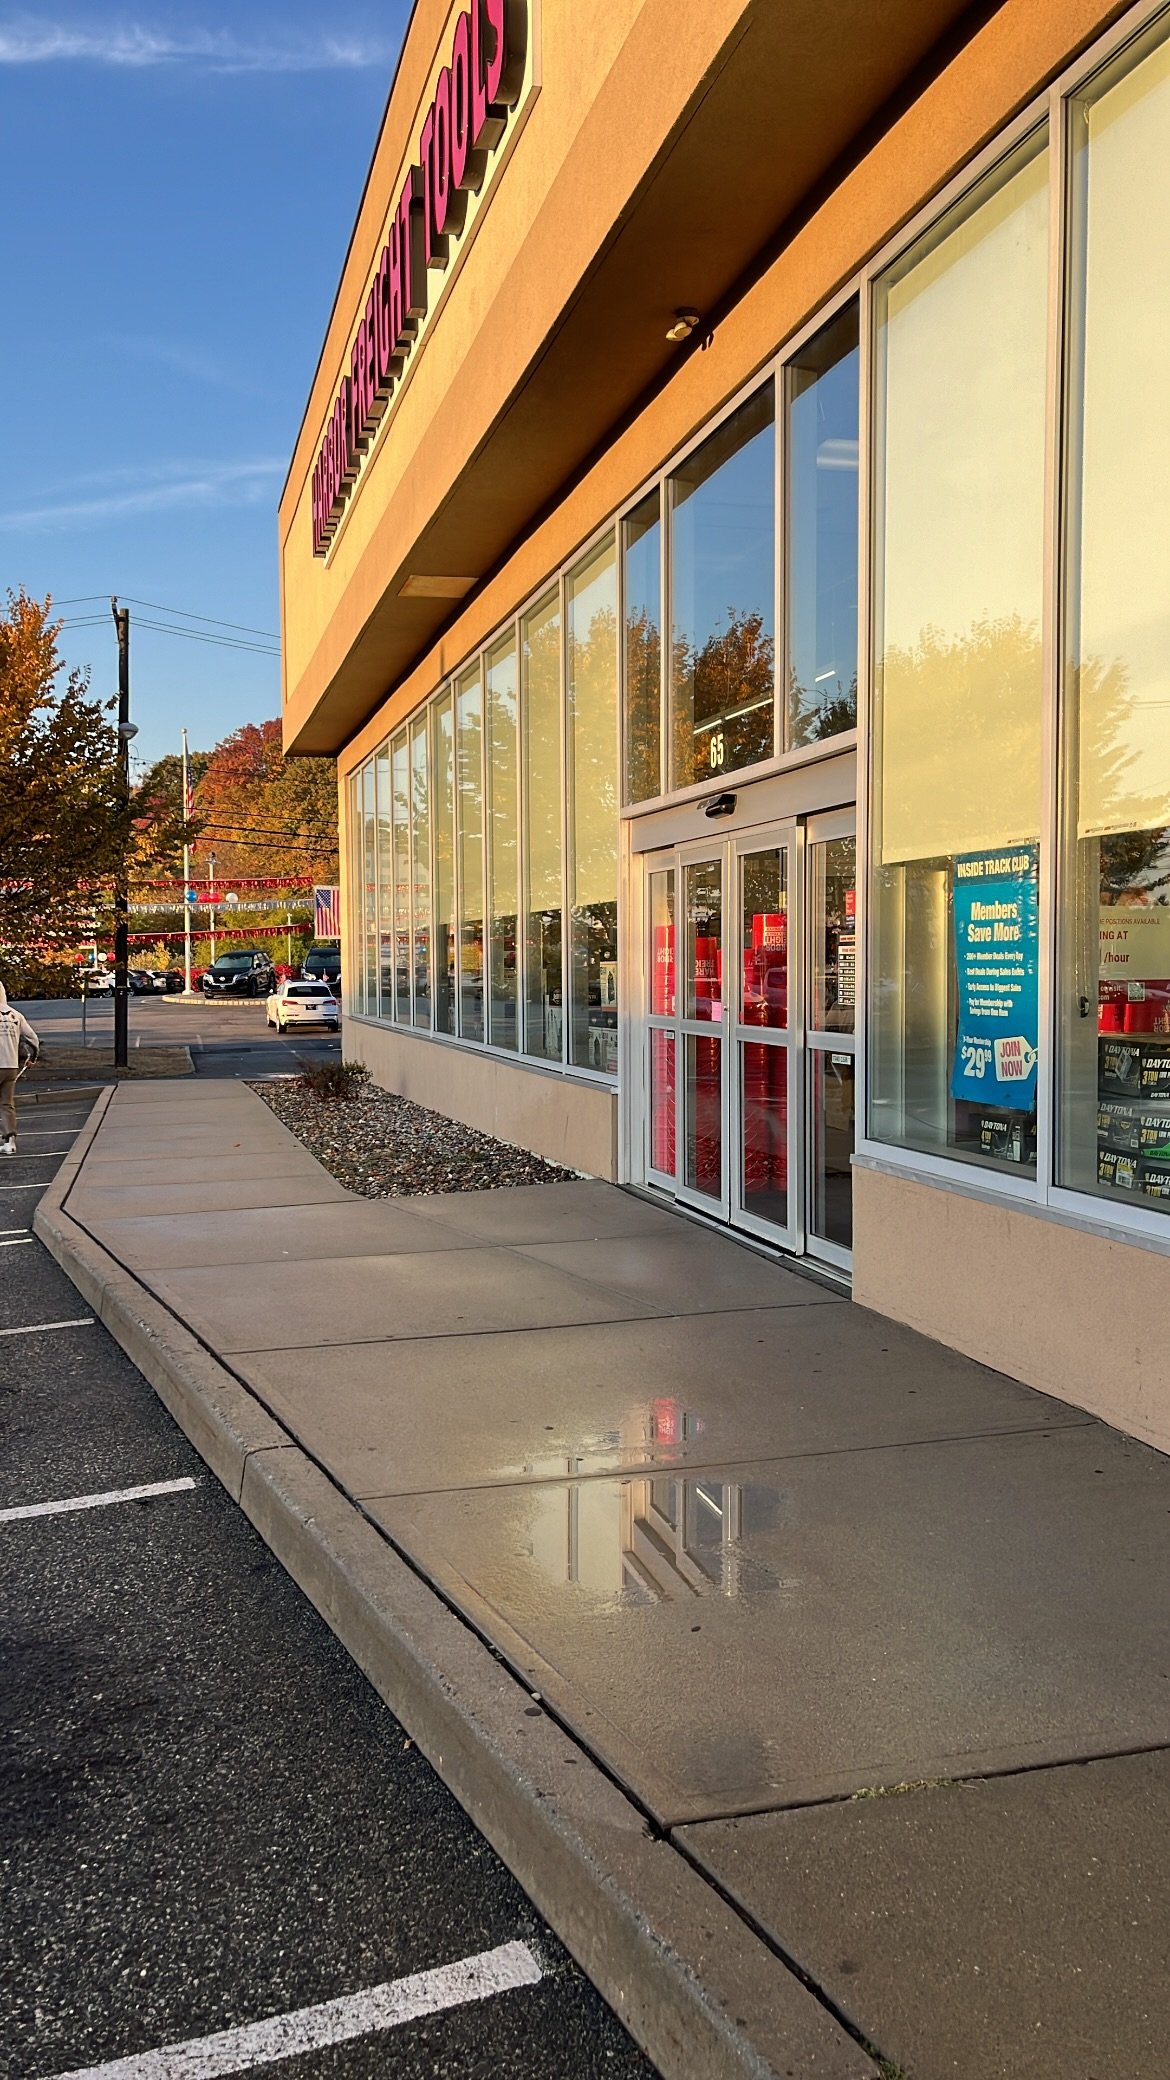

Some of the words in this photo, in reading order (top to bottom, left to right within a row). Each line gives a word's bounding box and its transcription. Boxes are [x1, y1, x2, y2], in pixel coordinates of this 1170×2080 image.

[312, 375, 352, 558] HARBOR
[351, 165, 417, 456] FREIGHT
[710, 733, 724, 768] 65
[958, 861, 984, 878] INSIDE
[984, 858, 1011, 875] TRACK
[1012, 854, 1029, 872] CLUB
[971, 900, 1018, 920] Members
[968, 924, 992, 942] Save
[994, 922, 1019, 942] More
[1116, 930, 1128, 940] AT
[1104, 952, 1130, 963] /hour
[1000, 1041, 1021, 1057] JOIN
[1109, 1045, 1140, 1056] DAYTONA
[1001, 1060, 1022, 1077] NOW
[1100, 1103, 1132, 1116] DAYTONA
[1104, 1153, 1137, 1168] DAYTONA
